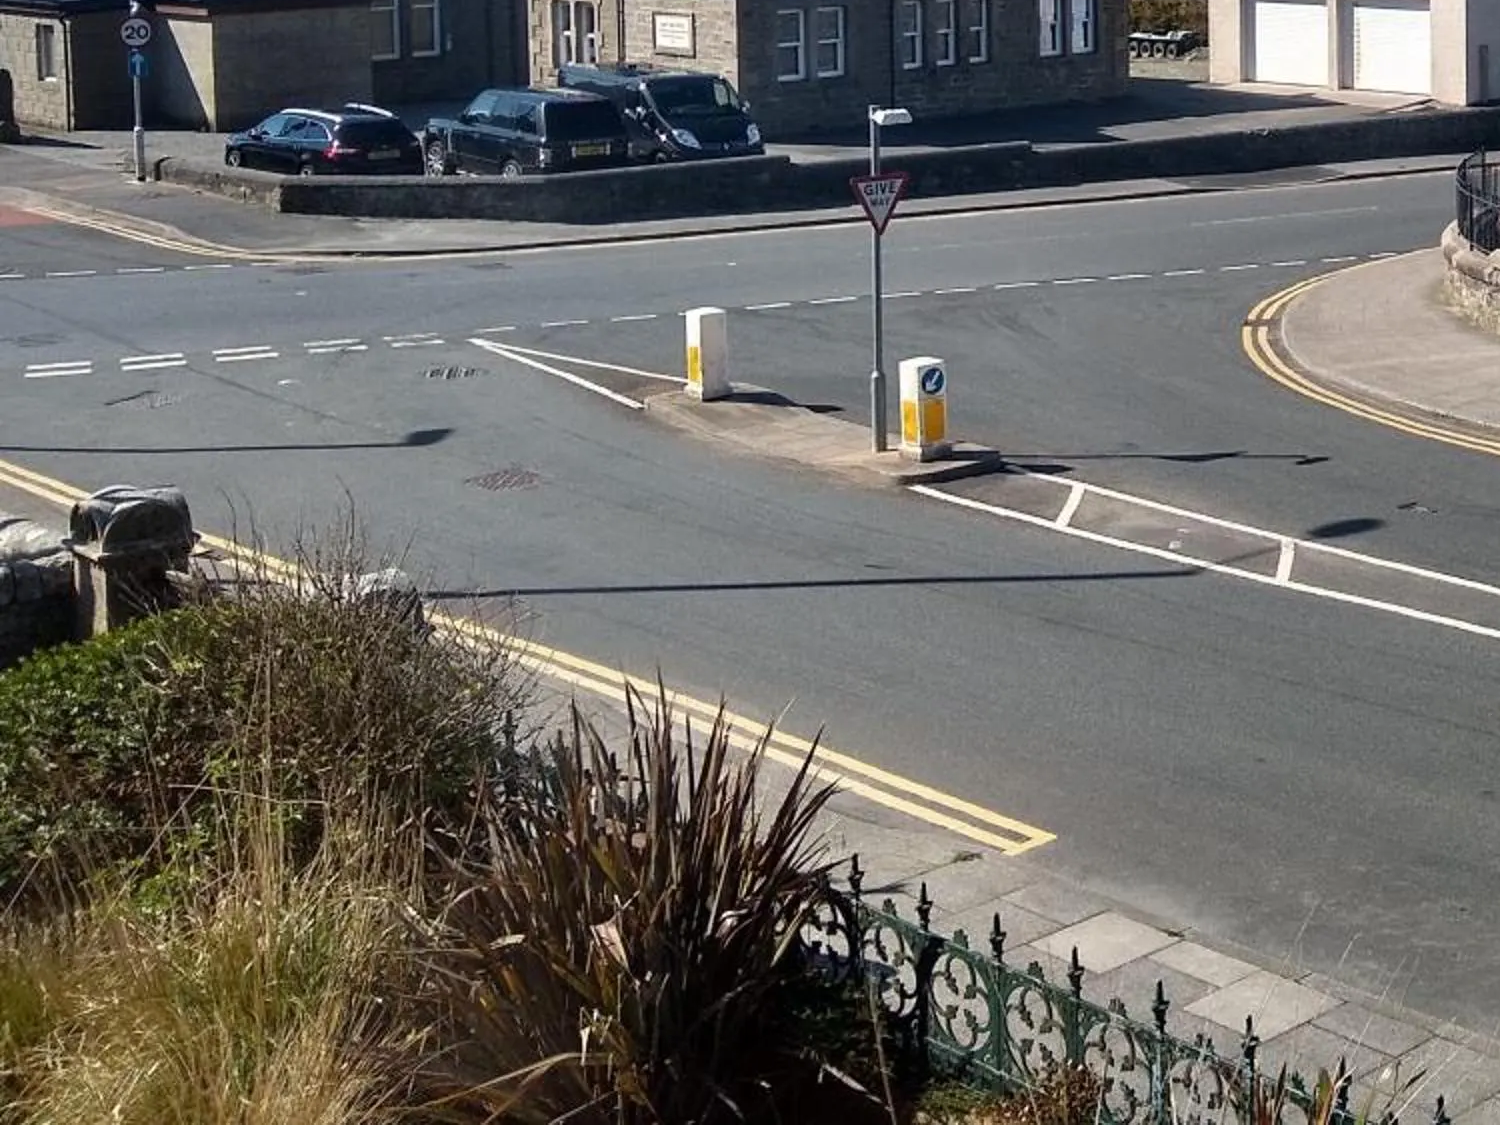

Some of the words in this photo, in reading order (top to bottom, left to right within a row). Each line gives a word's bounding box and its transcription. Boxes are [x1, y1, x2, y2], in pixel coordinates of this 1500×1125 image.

[124, 24, 149, 40] 20
[863, 181, 897, 196] GIVE
[870, 196, 891, 207] WAY
